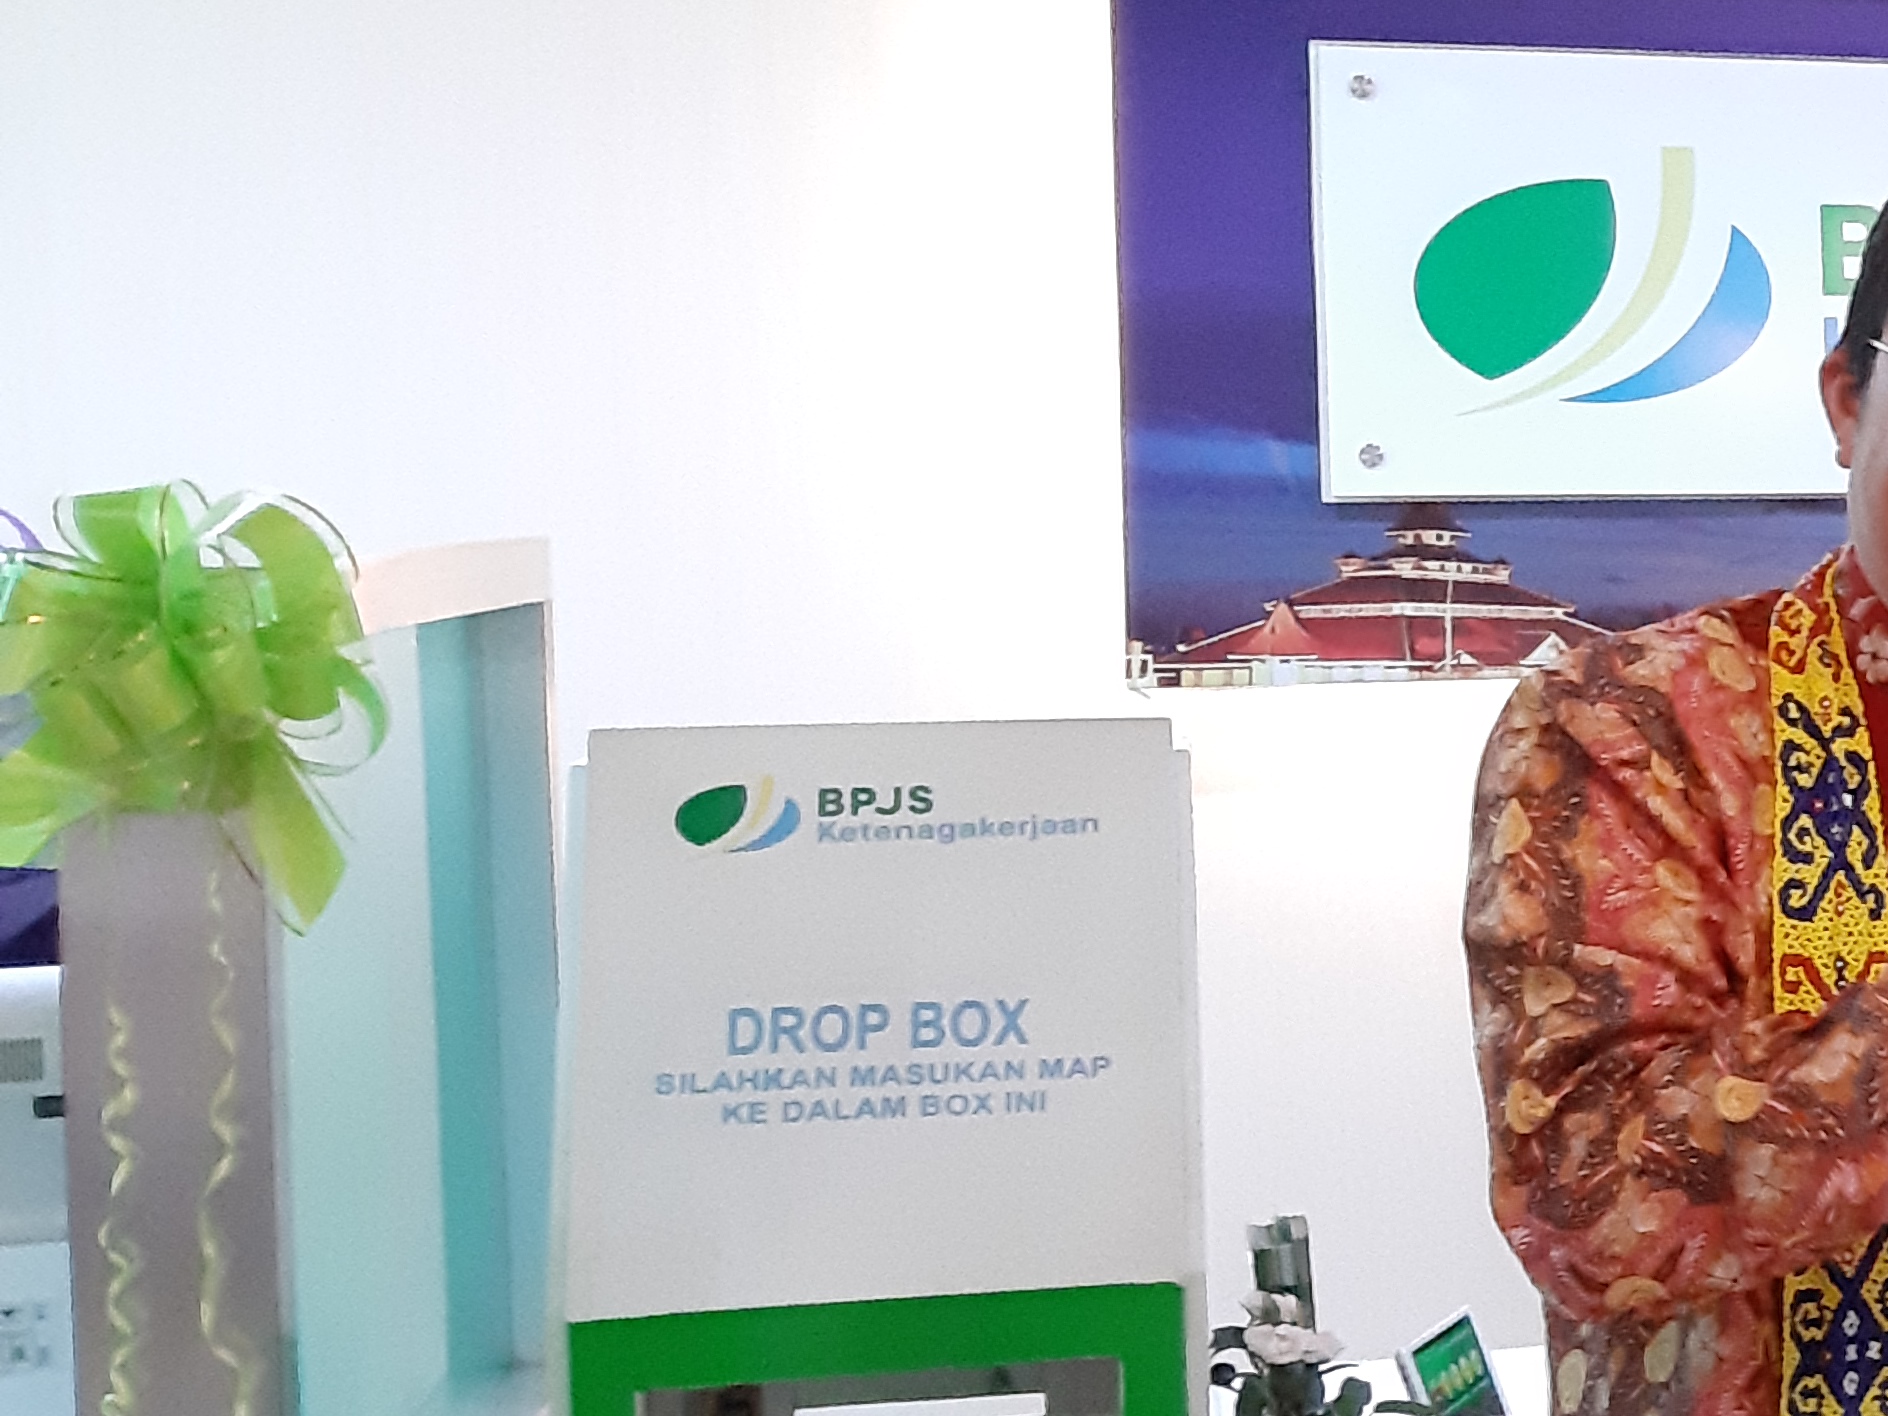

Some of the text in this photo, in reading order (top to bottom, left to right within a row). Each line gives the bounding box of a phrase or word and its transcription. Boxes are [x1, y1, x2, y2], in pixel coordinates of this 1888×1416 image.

[816, 784, 934, 818] BPJS
[816, 815, 1100, 844] Ketenagakerjaan
[727, 997, 1030, 1057] DROP BOX
[655, 1056, 1113, 1096] SILAHKAN MASUKAN MAP
[720, 1090, 1048, 1125] KE DALAM BOX INI
